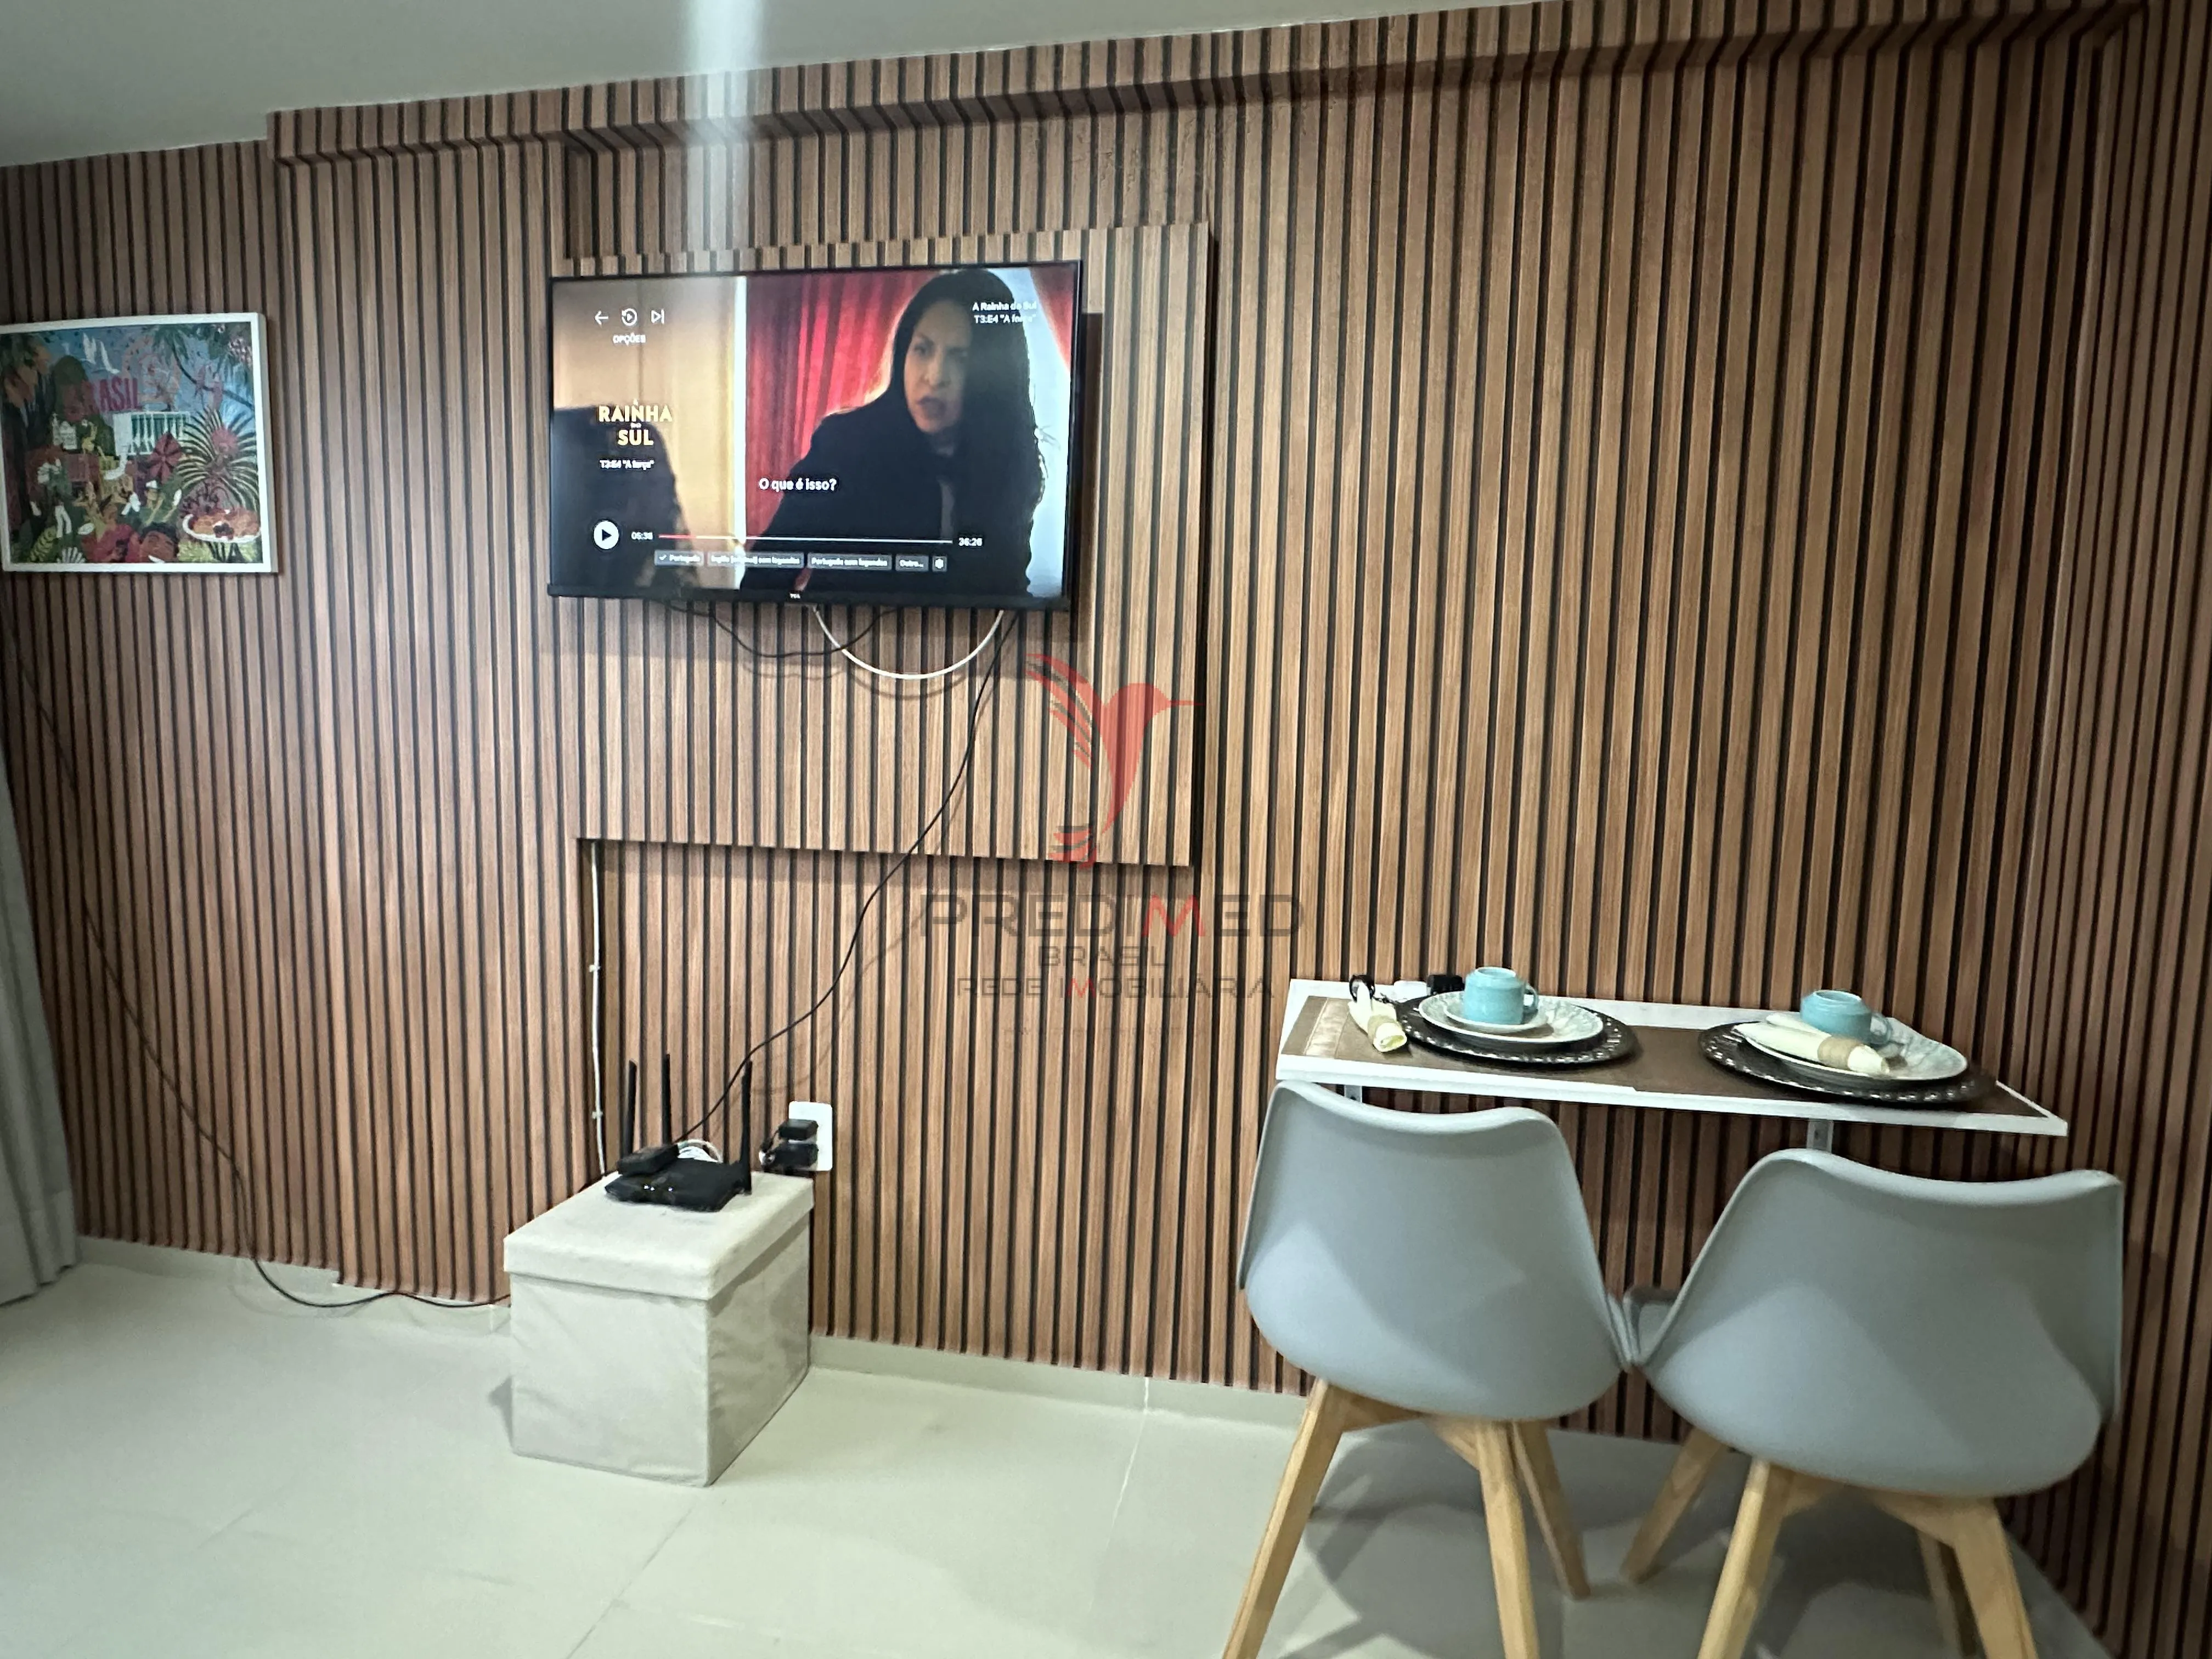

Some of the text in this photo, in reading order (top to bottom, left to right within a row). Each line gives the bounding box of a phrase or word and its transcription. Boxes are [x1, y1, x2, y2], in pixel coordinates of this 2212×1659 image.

[972, 302, 980, 311] A
[980, 302, 1009, 311] Rainha
[613, 332, 646, 347] OPÇÕES
[599, 404, 673, 422] RAINHA
[618, 429, 654, 445] SUL
[759, 477, 837, 492] O que é isso?
